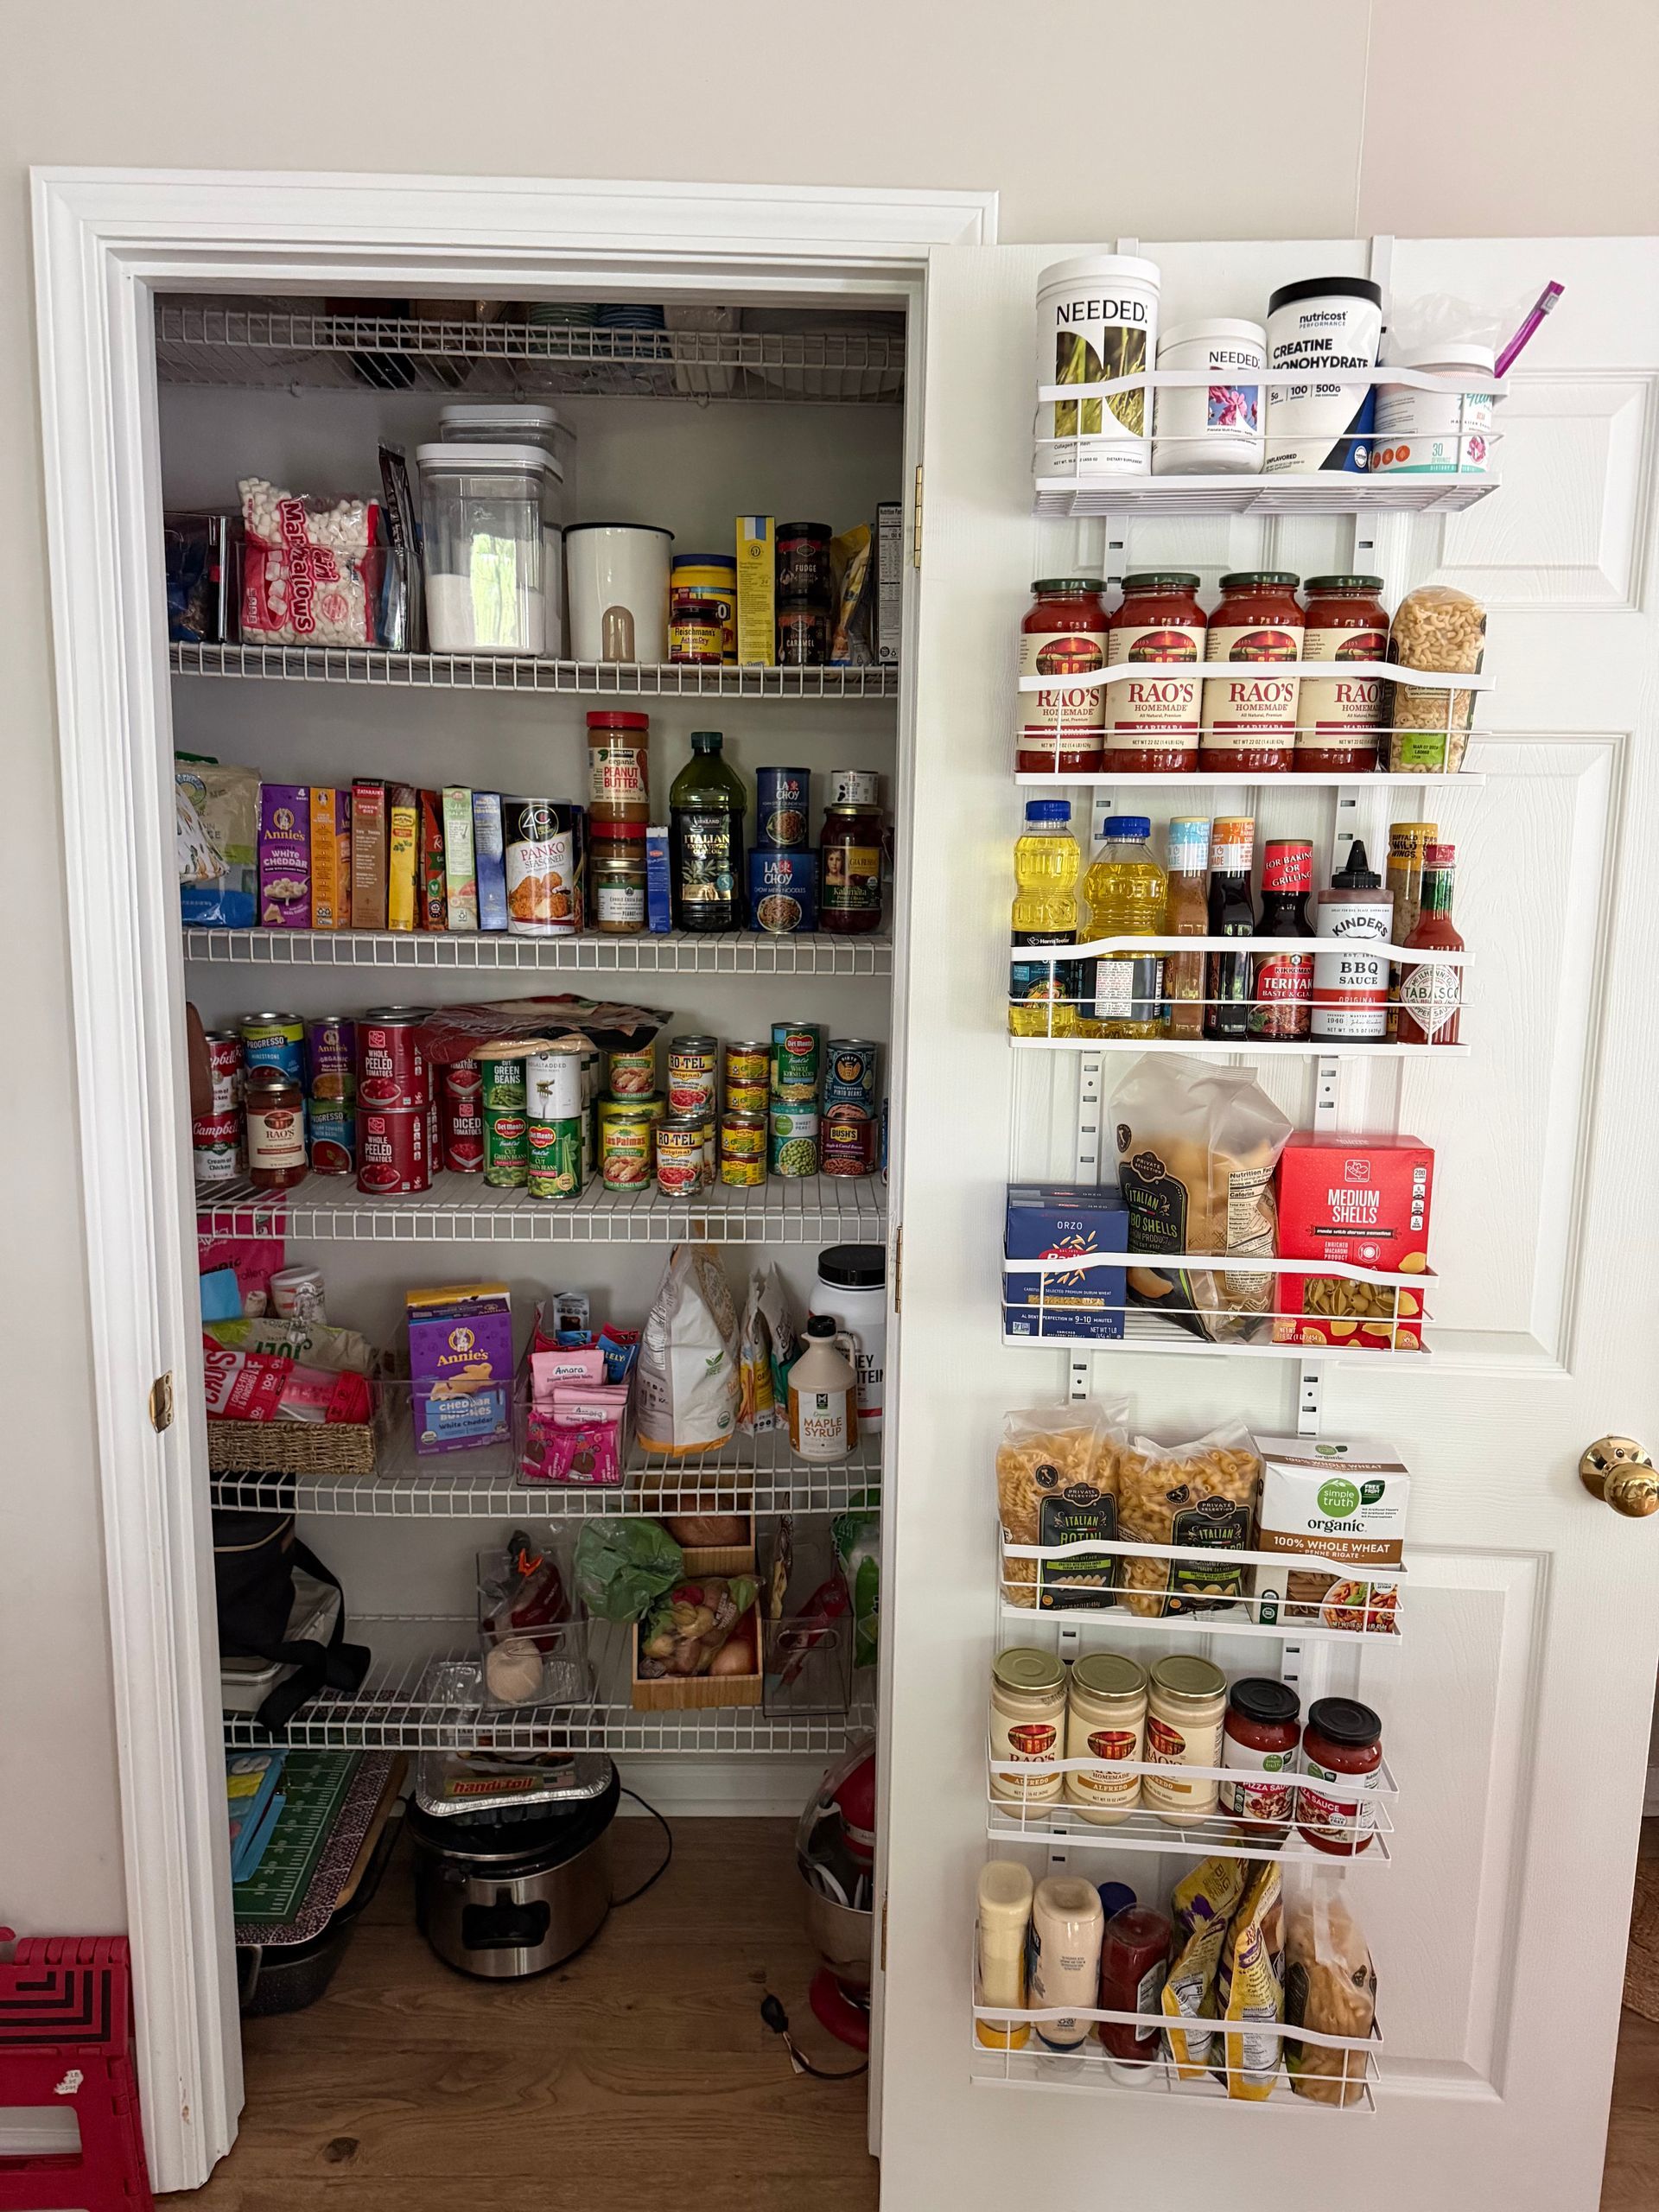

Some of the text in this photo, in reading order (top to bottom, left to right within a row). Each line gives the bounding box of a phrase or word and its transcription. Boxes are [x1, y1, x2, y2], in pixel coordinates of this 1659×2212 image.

[1300, 311, 1346, 323] nutricost
[1274, 338, 1332, 359] CREATINE
[1291, 385, 1307, 396] 100
[1433, 442, 1443, 456] 30
[1267, 454, 1297, 465] UNFLAVORED
[795, 564, 817, 573] FUDGE
[675, 627, 715, 638] Fleischmann's
[1128, 683, 1194, 702] RAO'S
[1229, 683, 1294, 702] RAO'S
[608, 757, 635, 766] organic
[604, 767, 639, 778] PEANUT
[604, 778, 638, 789] BUTTER
[776, 781, 789, 791] LA
[776, 791, 799, 800] CHOY
[264, 830, 305, 842] Annie's
[684, 834, 730, 843] ITALIAN
[1393, 841, 1417, 850] WILD
[520, 842, 566, 861] PANKO
[524, 855, 564, 869] SEASONED
[765, 861, 778, 873] LA
[1266, 858, 1281, 868] FOR
[1285, 864, 1300, 873] OR
[764, 874, 793, 885] CHOY
[1272, 872, 1313, 887] GRILLING
[1332, 917, 1388, 937] KINDER'S
[1340, 962, 1378, 975] BBQ
[247, 1038, 284, 1049] PROGRESSO
[365, 1058, 392, 1070] PEELED
[494, 1075, 520, 1084] BEANS
[453, 1118, 480, 1128] DICED
[265, 1129, 295, 1139] RAO'S
[832, 1129, 856, 1138] BUSH'S
[365, 1144, 392, 1154] PEELED
[1135, 1163, 1161, 1174] SELECTION
[1136, 1158, 1160, 1169] PRIVATE
[1230, 1170, 1262, 1179] Nutrition
[1327, 1189, 1380, 1207] MEDIUM
[1332, 1206, 1377, 1224] SHELLS
[1057, 1221, 1083, 1230] ORZO
[1142, 1217, 1178, 1237] SHELLS
[437, 1349, 489, 1367] Annie's
[439, 1417, 493, 1430] White Cheddar
[804, 1417, 842, 1428] MAPLE
[804, 1427, 842, 1438] SYRUP
[1324, 1490, 1355, 1499] simple
[1324, 1497, 1354, 1508] truth
[1065, 1516, 1099, 1527] ITALIAN
[1307, 1519, 1364, 1533] organic
[1199, 1529, 1234, 1539] ITALIAN
[1274, 1535, 1390, 1554] 100% WHOLE WHEAT
[1093, 1783, 1128, 1791] ALFREDO
[1243, 1782, 1269, 1791] PIZZA
[1312, 1796, 1340, 1812] SAUCE
[1213, 1863, 1231, 1890] BIG
